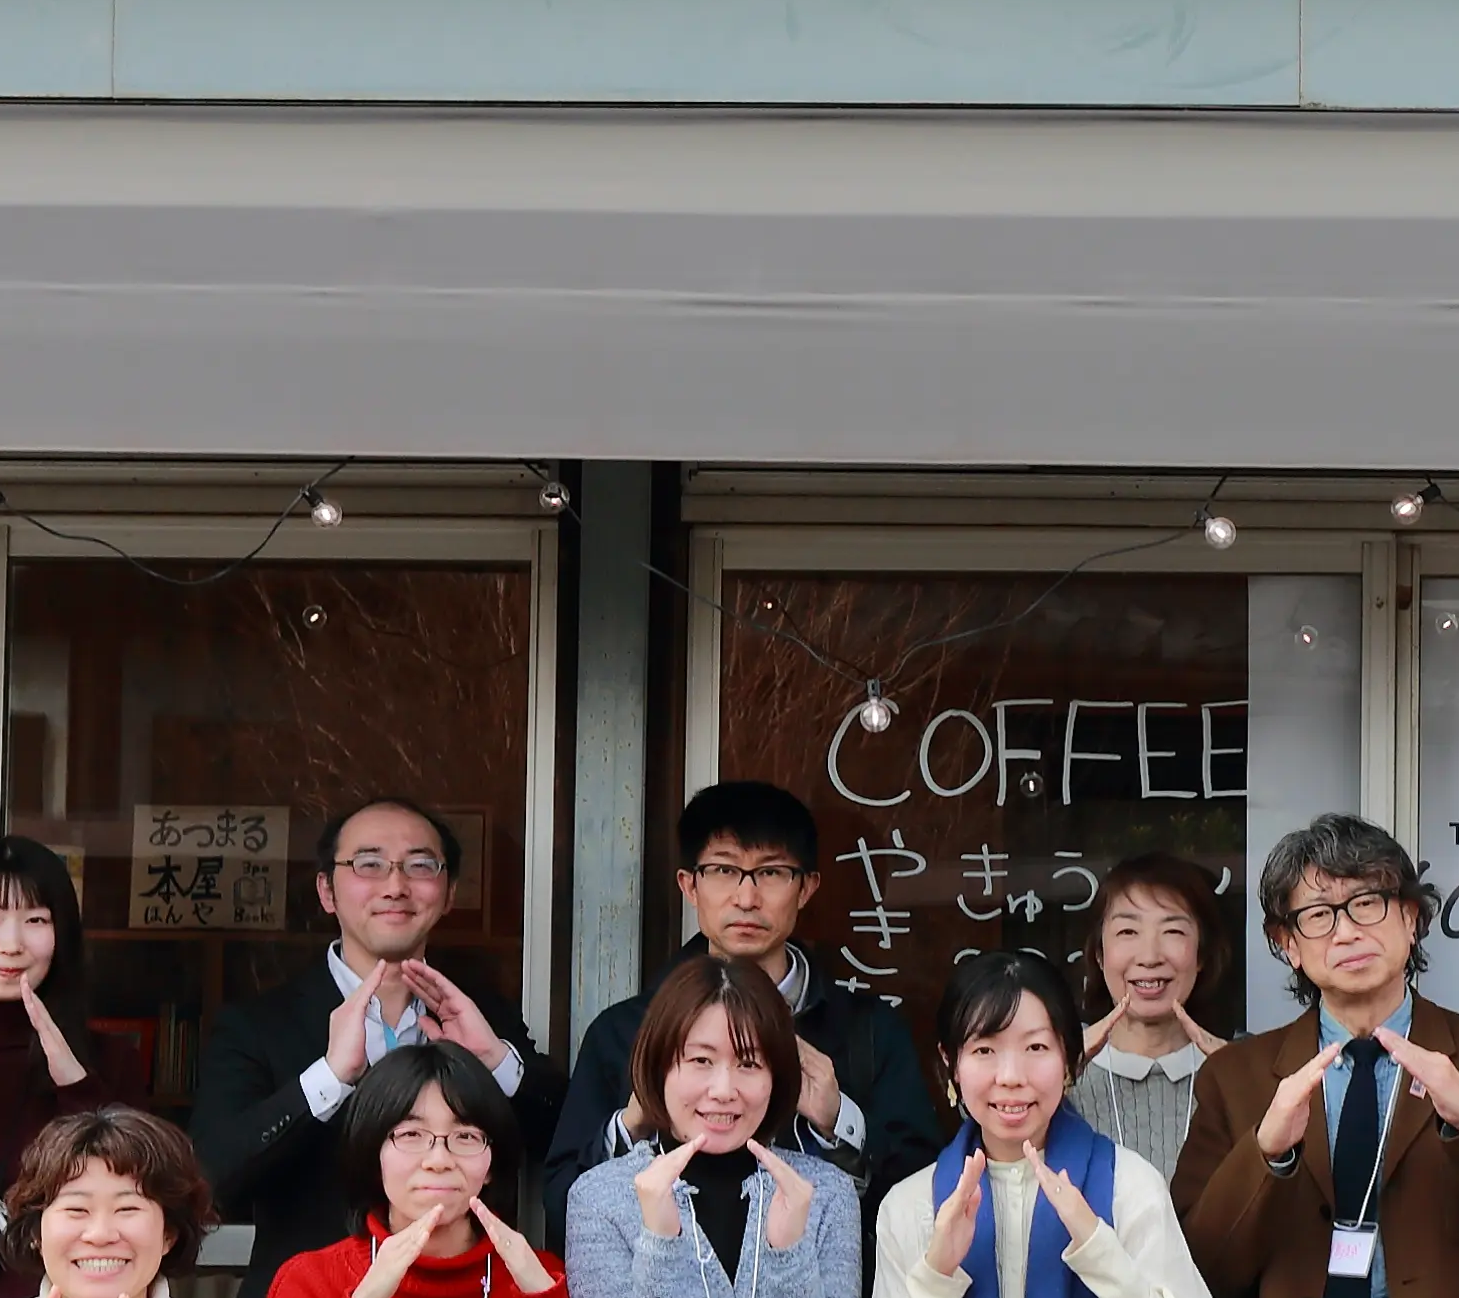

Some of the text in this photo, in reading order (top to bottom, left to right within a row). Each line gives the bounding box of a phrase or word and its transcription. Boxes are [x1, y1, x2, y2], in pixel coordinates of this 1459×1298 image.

[828, 698, 1249, 807] COFFEE
[148, 808, 269, 853] あつまる
[138, 855, 224, 904] 本屋
